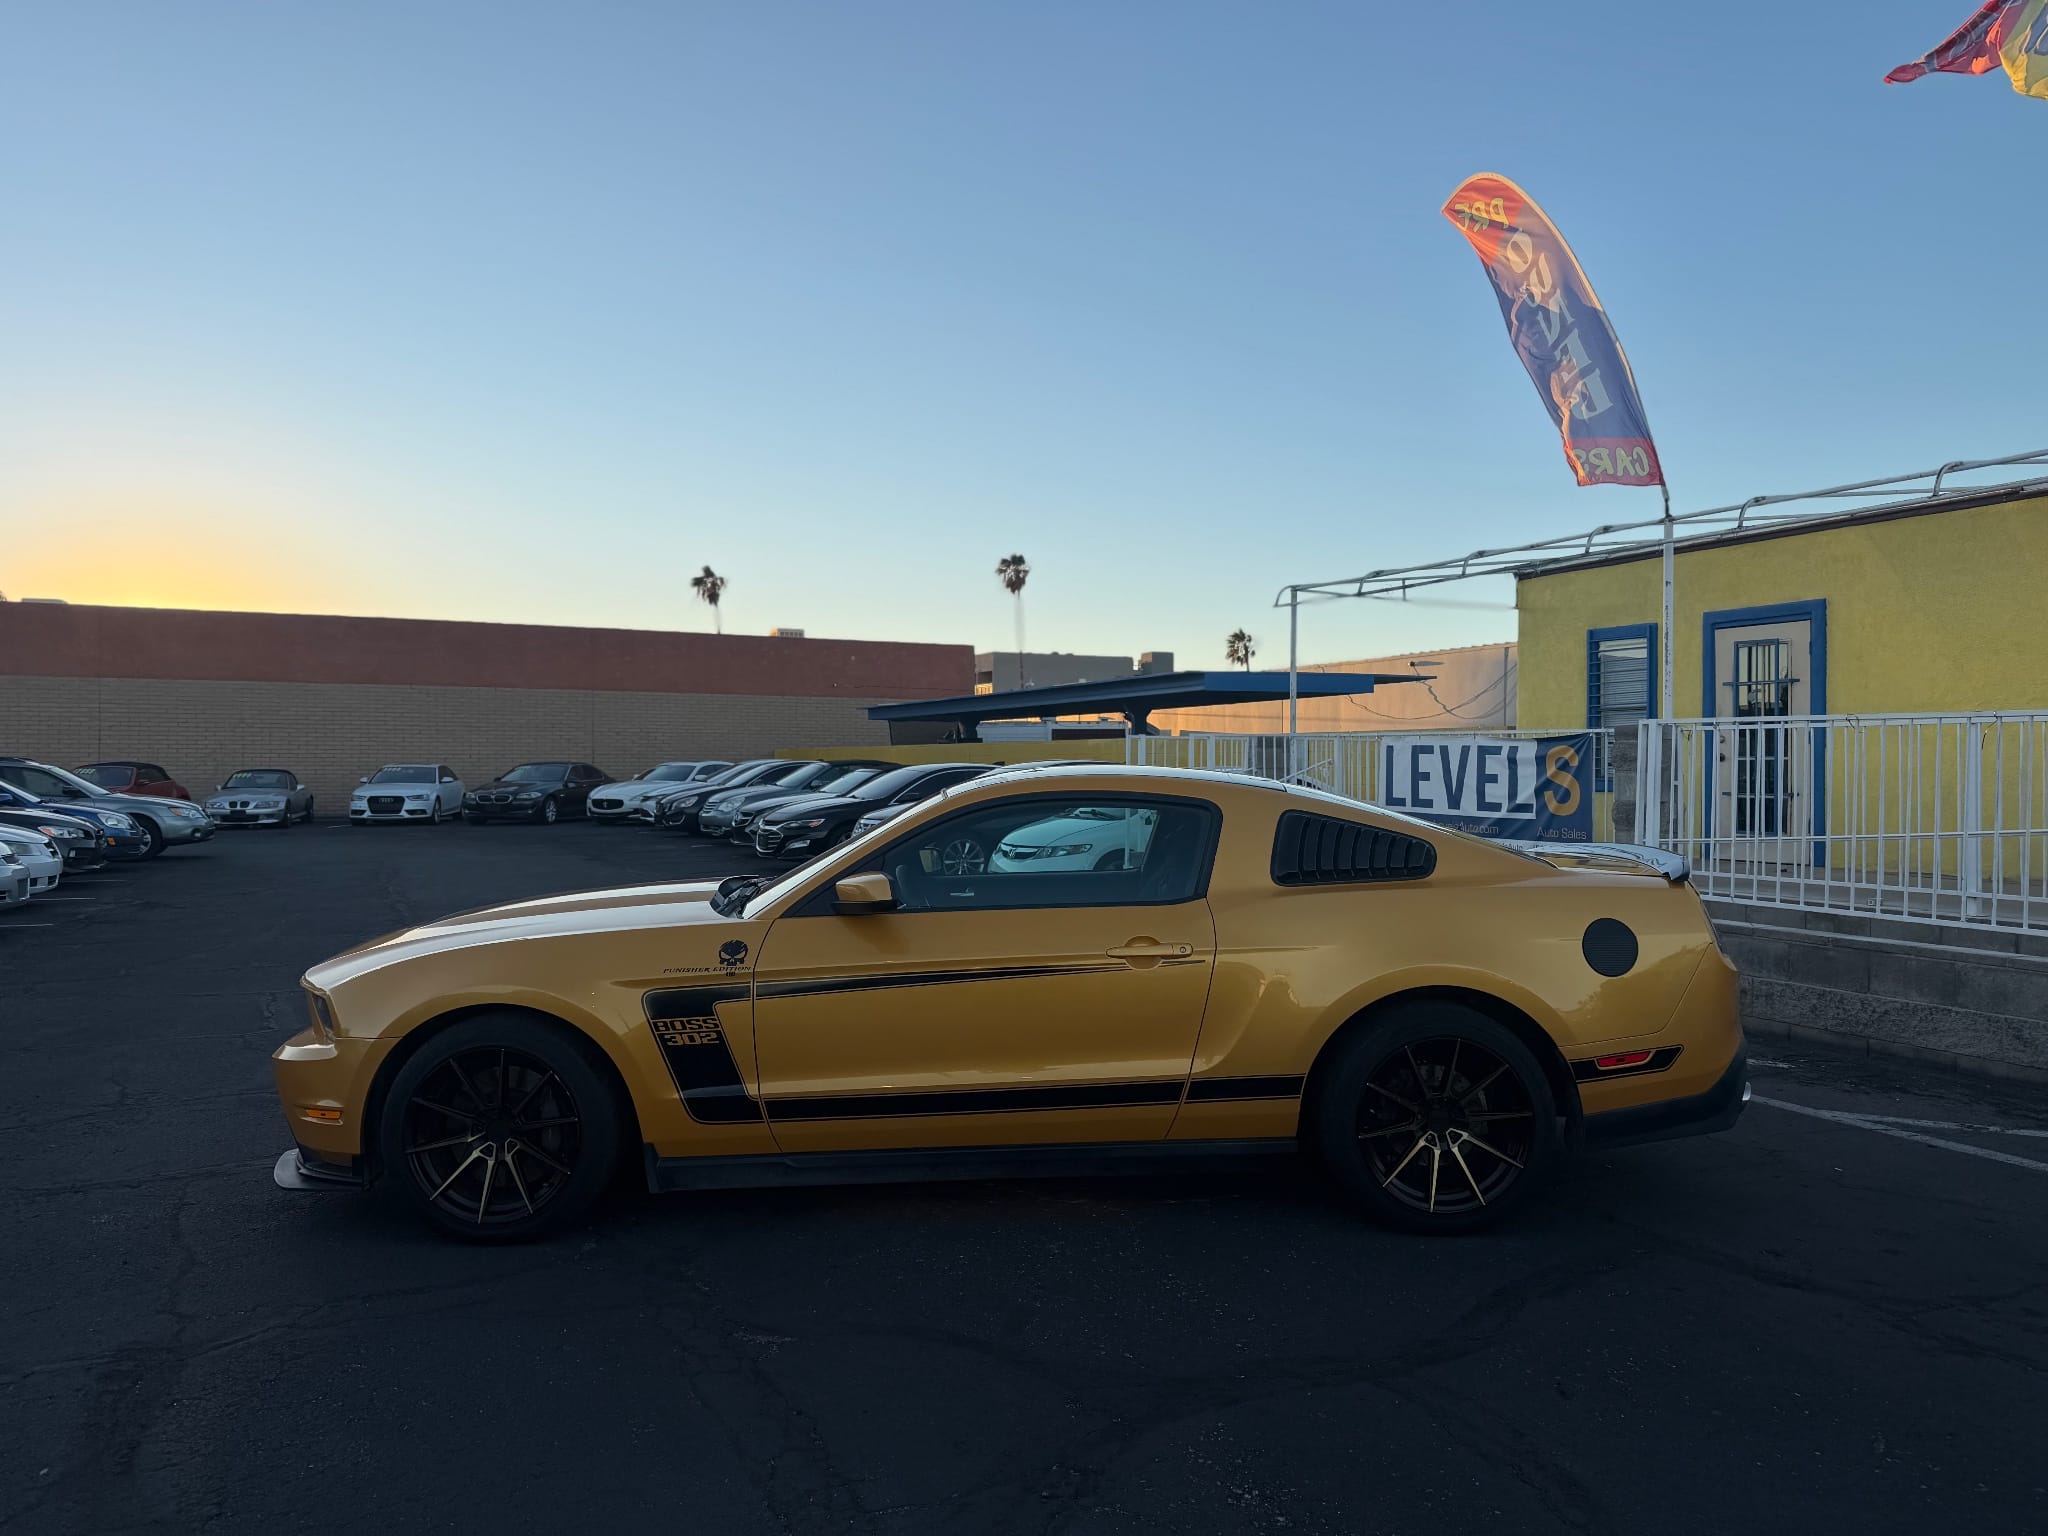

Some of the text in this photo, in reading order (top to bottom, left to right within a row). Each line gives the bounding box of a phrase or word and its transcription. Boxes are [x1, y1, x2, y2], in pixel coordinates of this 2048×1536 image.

[1536, 826, 1587, 840] Auto Sales
[663, 966, 710, 974] PUNISHER
[653, 1018, 720, 1032] BOSS
[664, 1033, 720, 1045] 302
